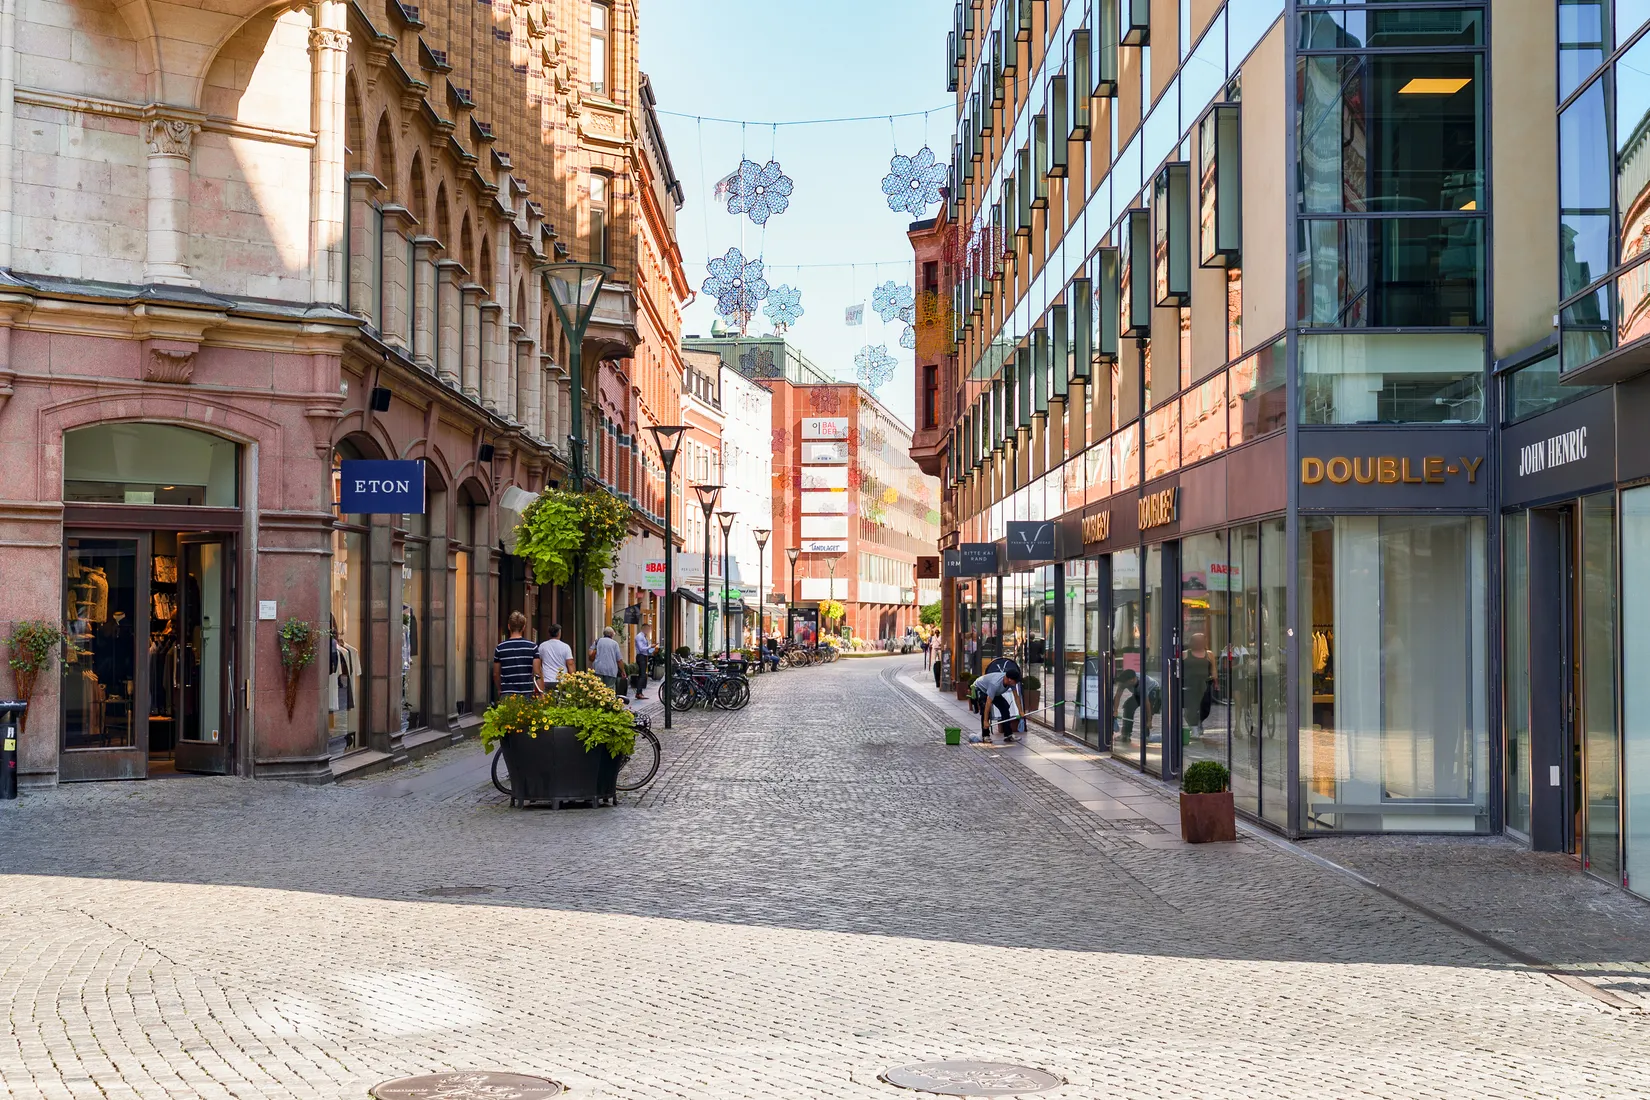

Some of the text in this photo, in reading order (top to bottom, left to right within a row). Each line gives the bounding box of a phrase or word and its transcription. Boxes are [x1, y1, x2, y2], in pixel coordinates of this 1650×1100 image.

[1519, 425, 1587, 477] JOHN HENRIC
[1301, 455, 1485, 485] DOUBLE-Y
[354, 479, 411, 494] ETON
